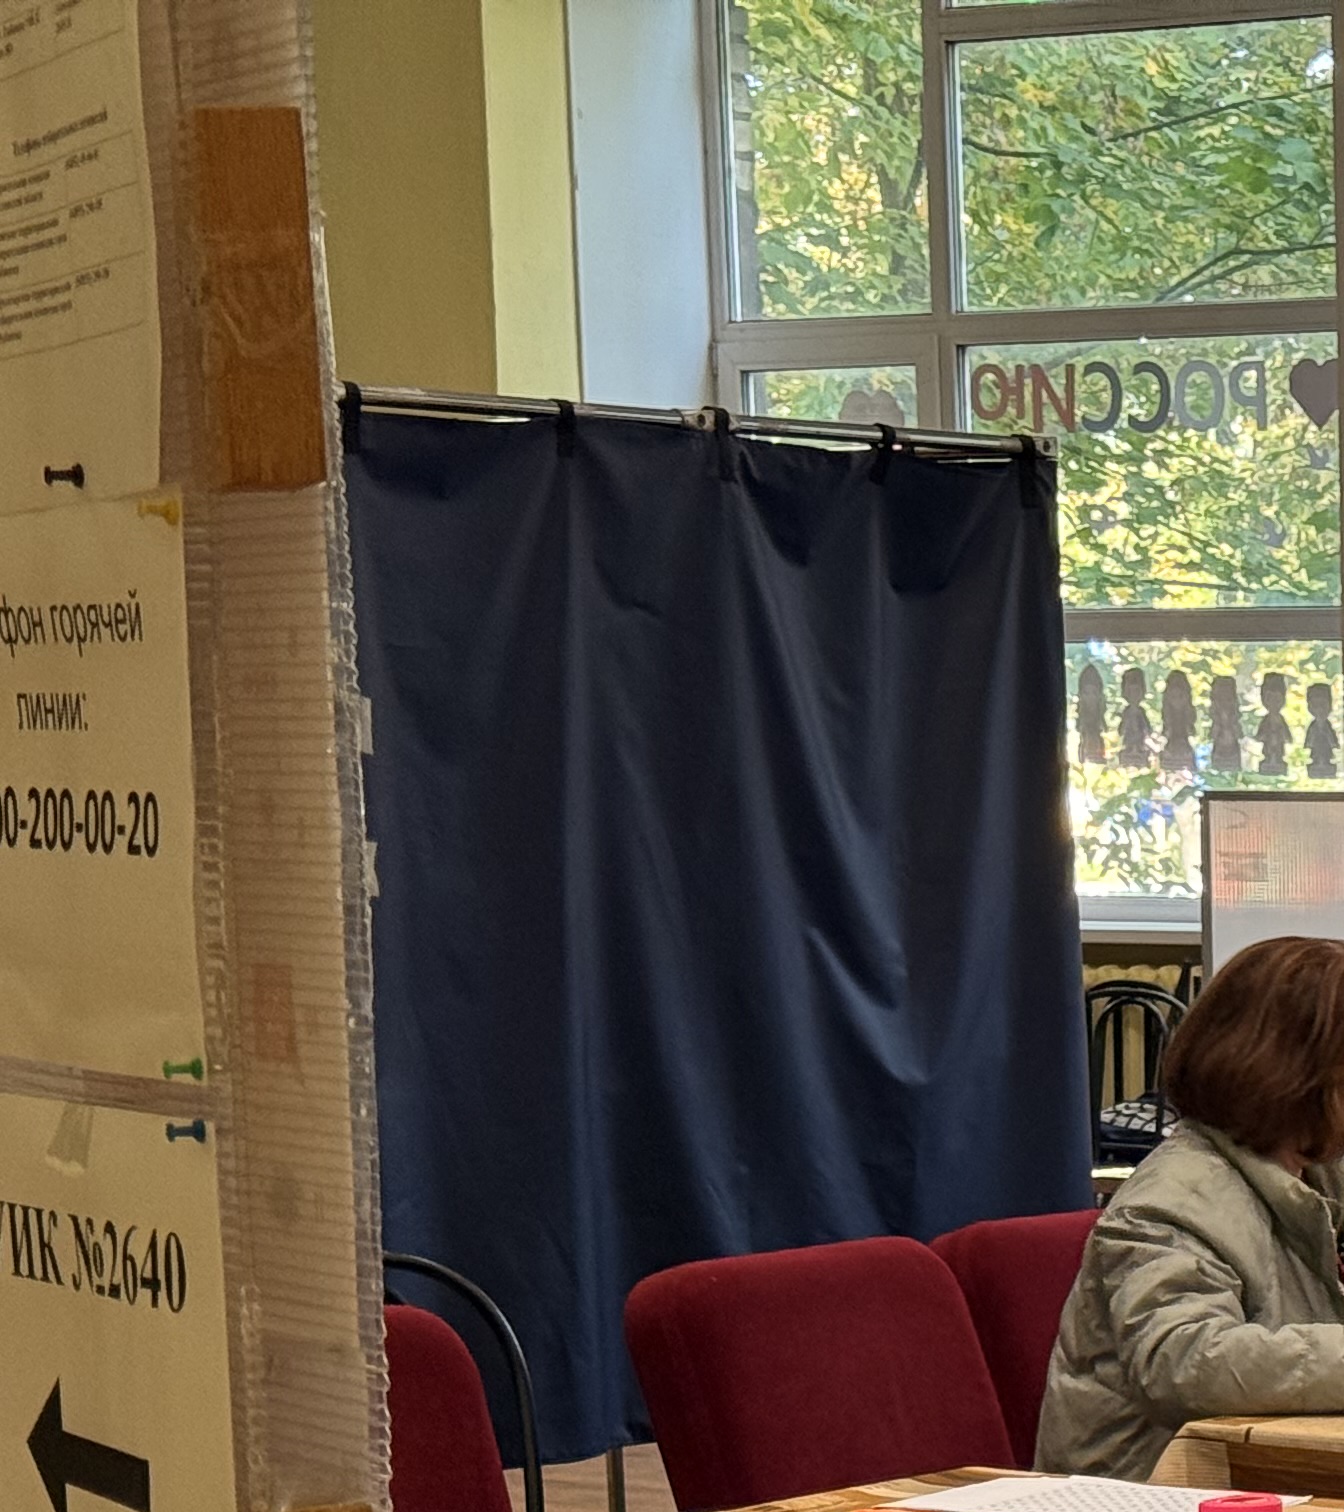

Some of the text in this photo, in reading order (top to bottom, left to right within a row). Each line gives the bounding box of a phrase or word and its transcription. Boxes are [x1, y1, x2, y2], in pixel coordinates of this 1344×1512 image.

[49, 588, 144, 659] горячей
[16, 691, 89, 732] линии:
[0, 785, 160, 859] 0-200-00-20
[67, 1213, 188, 1315] №2640
